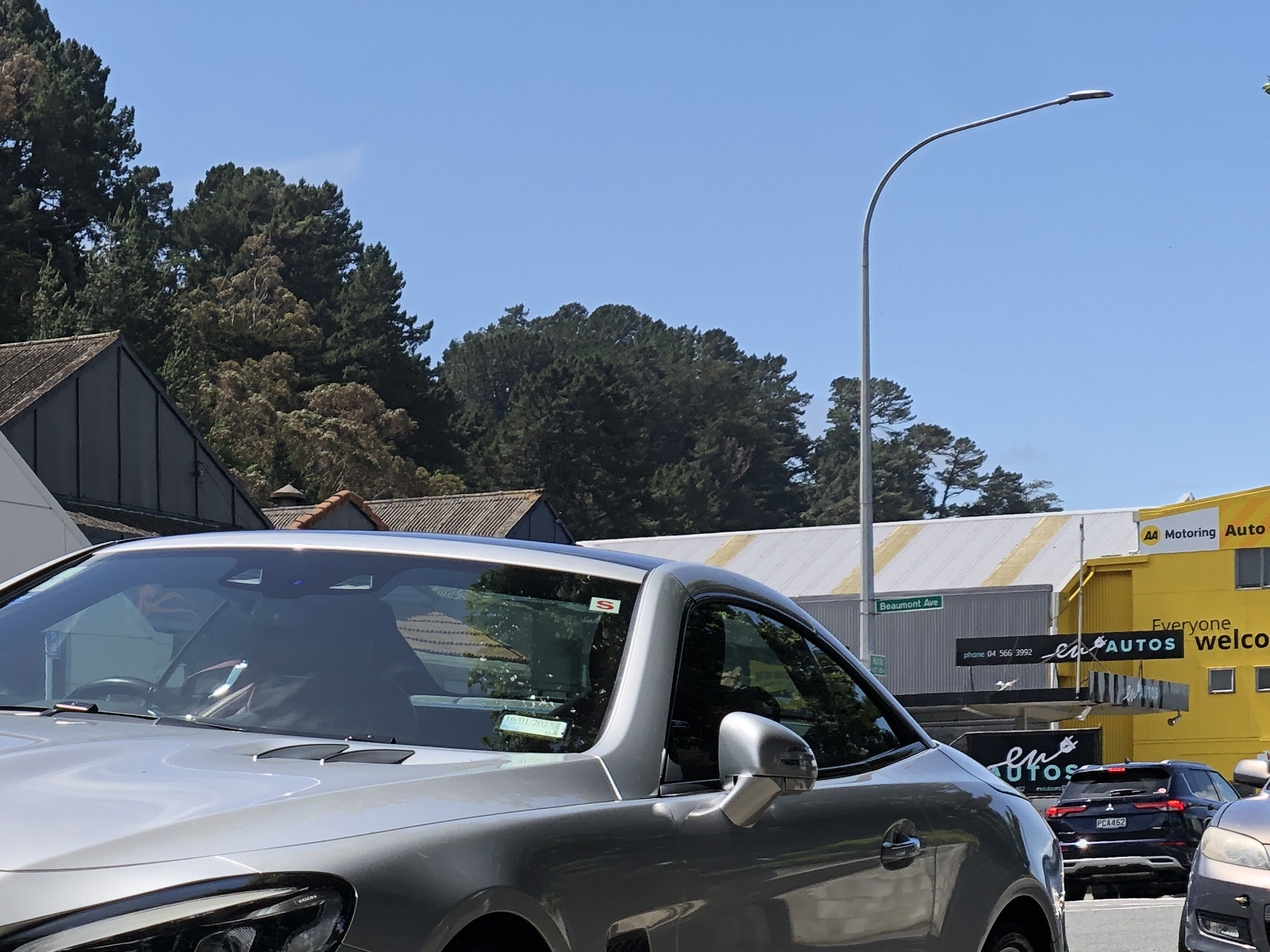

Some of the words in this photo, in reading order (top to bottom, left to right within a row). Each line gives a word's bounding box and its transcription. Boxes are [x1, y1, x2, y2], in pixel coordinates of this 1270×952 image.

[1144, 530, 1159, 540] AA
[1164, 527, 1217, 540] Motoring
[1224, 524, 1266, 538] Auto
[596, 599, 615, 611] S
[879, 599, 922, 611] Beaumont
[923, 598, 939, 607] Ave
[1152, 617, 1232, 636] Everyone
[963, 651, 985, 660] phone
[986, 650, 997, 658] 04
[999, 649, 1013, 658] 566
[1015, 648, 1033, 657] 3992
[1105, 637, 1177, 654] AUTOS
